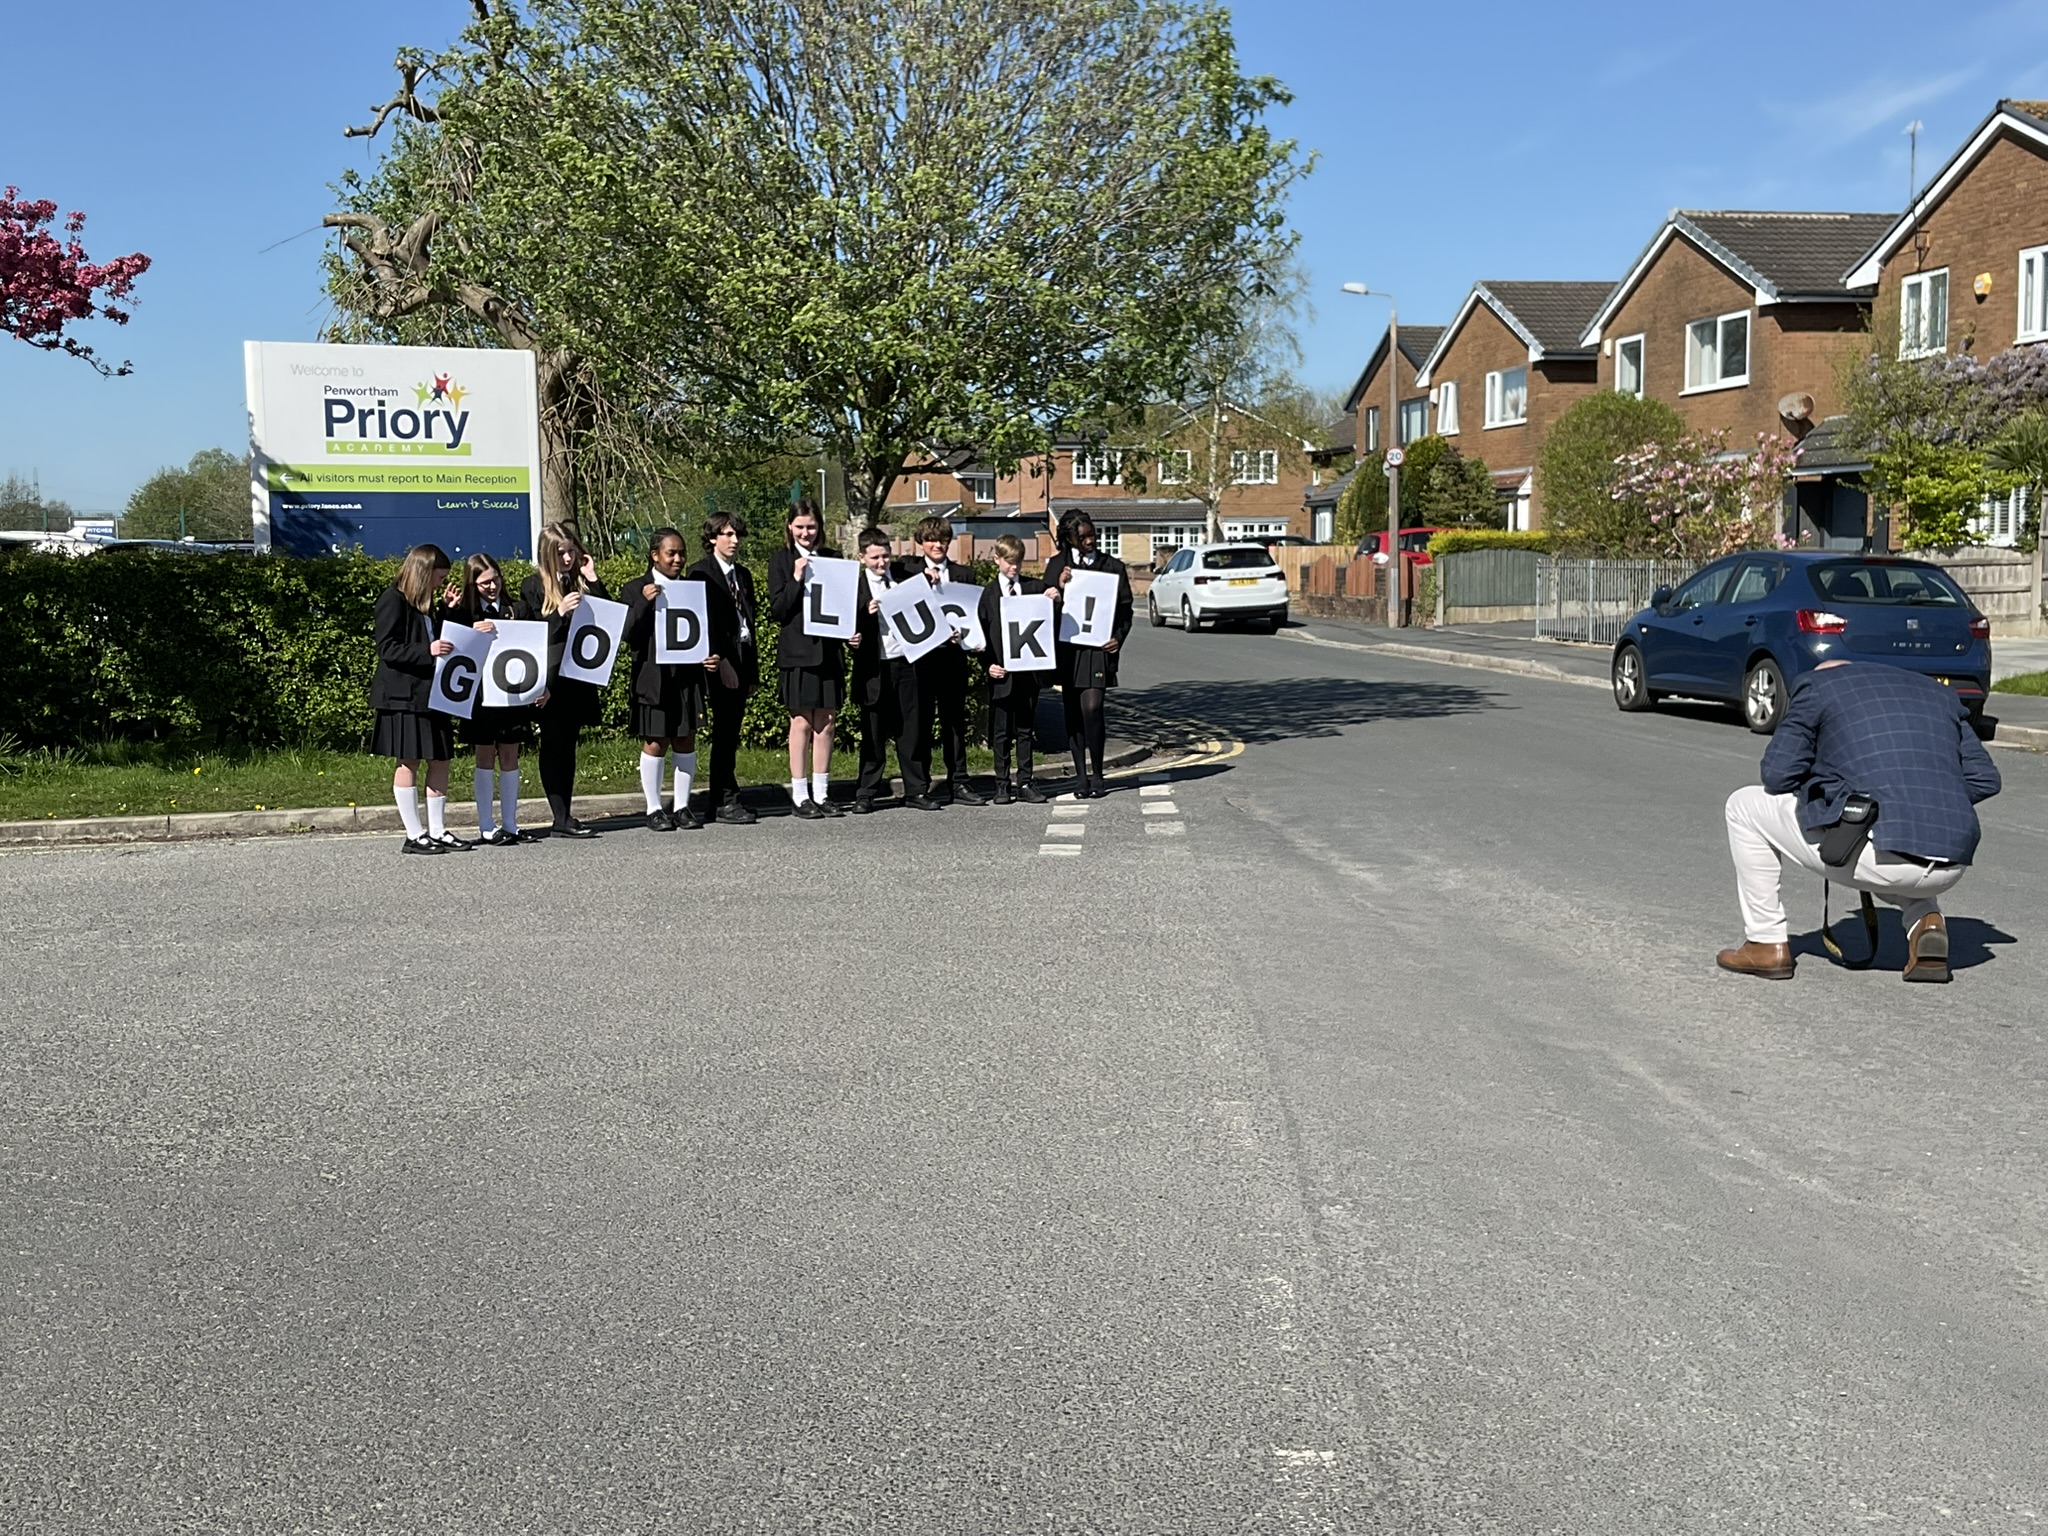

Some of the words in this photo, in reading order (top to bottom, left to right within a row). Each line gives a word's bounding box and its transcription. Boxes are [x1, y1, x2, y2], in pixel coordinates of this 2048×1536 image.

[291, 365, 349, 377] Welcome
[353, 367, 364, 377] to
[324, 385, 399, 397] Penwortham
[324, 398, 470, 450] Priory
[332, 443, 426, 453] ACADEMY
[300, 472, 313, 483] All
[316, 473, 355, 483] visitors
[358, 474, 385, 484] must
[388, 474, 420, 486] report
[422, 474, 433, 484] to
[436, 474, 462, 484] Main
[465, 474, 517, 486] Reception
[436, 499, 468, 509] Learn
[470, 498, 480, 510] to
[482, 497, 519, 510] Succeed
[810, 583, 840, 625] L
[891, 599, 937, 645] U
[1008, 619, 1048, 659] K
[440, 655, 477, 702] G
[492, 649, 539, 694] O
[571, 624, 611, 670] O
[666, 608, 701, 651] D
